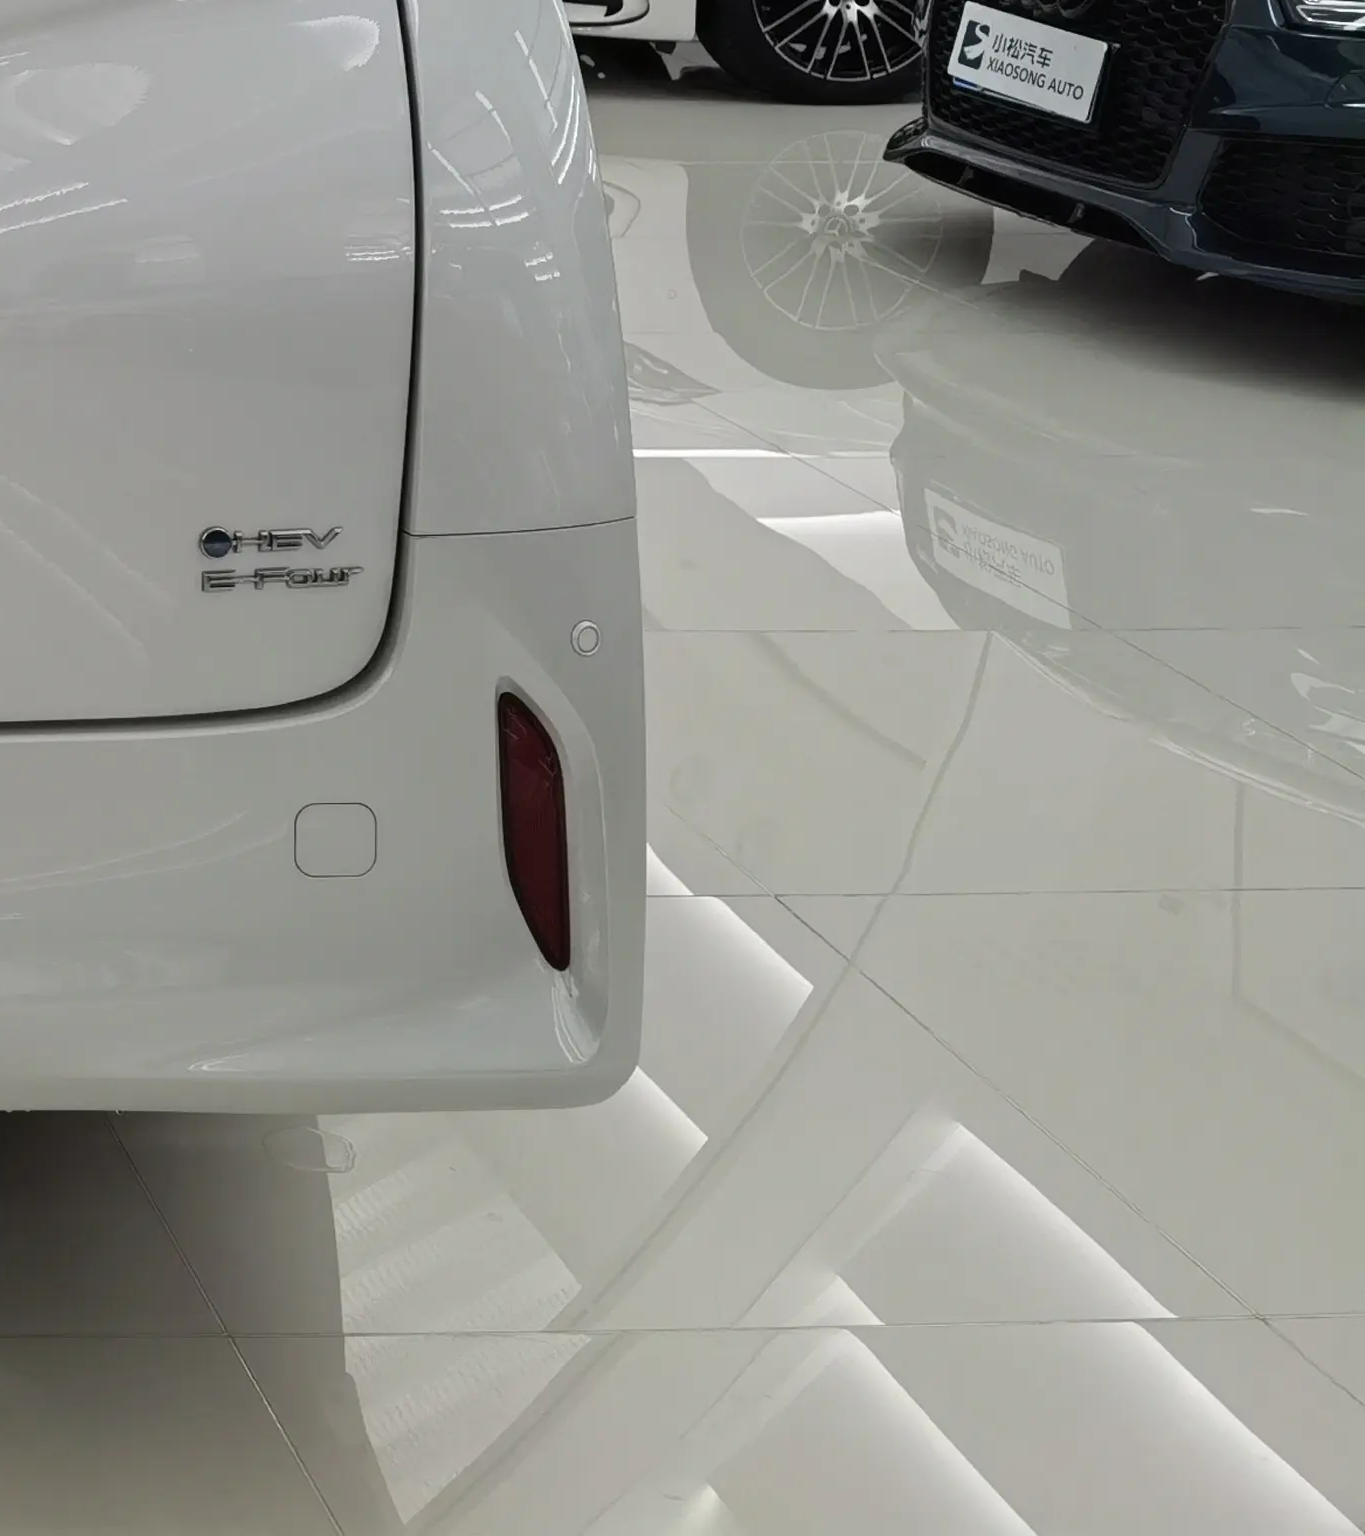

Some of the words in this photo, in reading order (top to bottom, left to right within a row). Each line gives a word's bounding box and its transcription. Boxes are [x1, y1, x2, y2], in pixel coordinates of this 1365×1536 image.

[991, 33, 1054, 69] 小松汽车
[986, 56, 1048, 89] XIAOSONG
[1047, 77, 1084, 100] AUTO
[201, 565, 365, 593] E-Four
